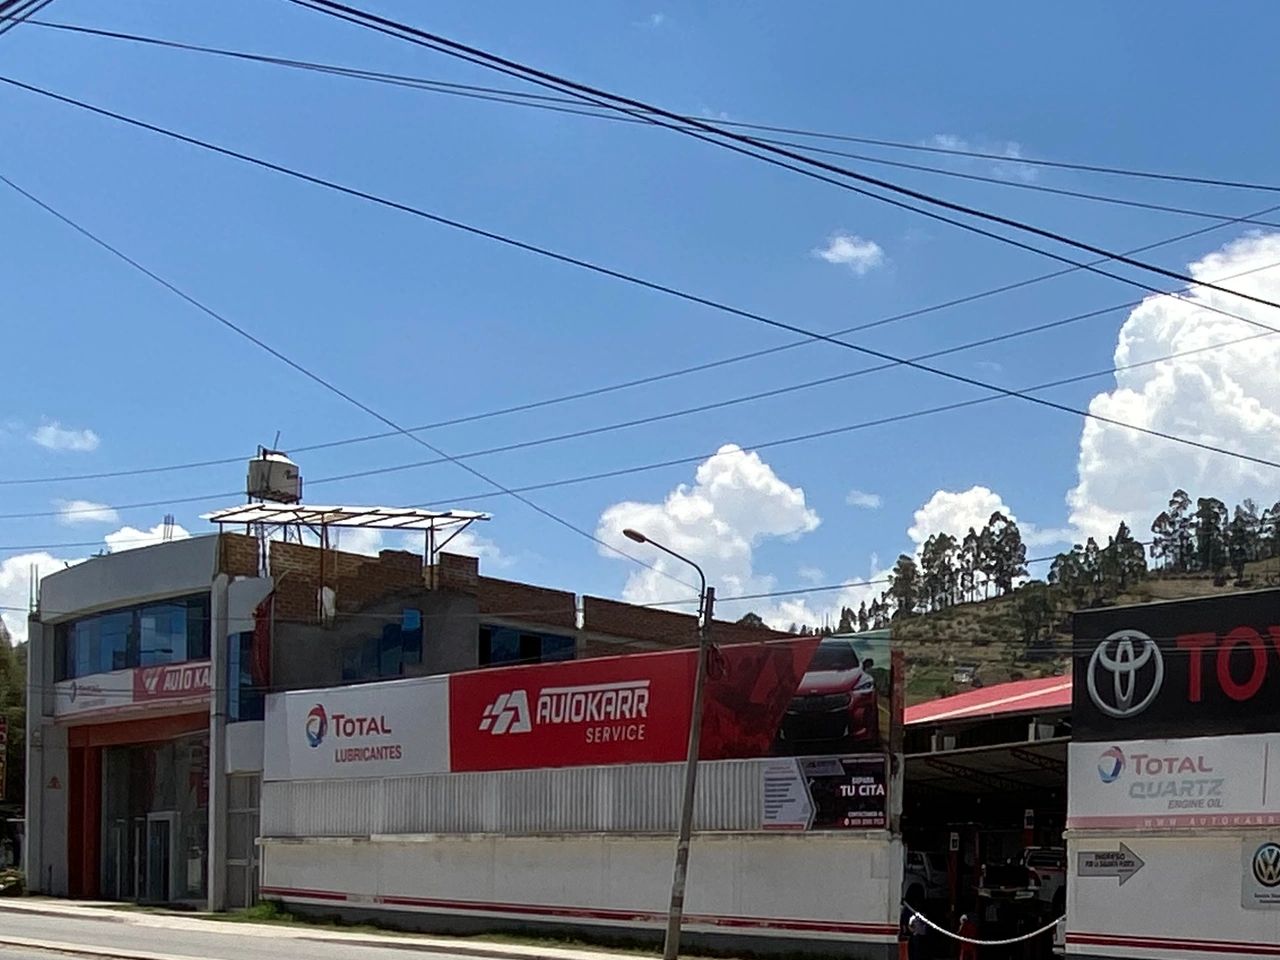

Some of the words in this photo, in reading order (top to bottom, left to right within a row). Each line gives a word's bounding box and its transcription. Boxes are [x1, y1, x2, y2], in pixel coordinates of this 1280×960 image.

[163, 667, 192, 691] AUTO
[536, 680, 650, 724] AUTOKARR
[332, 714, 392, 737] TOTAL
[586, 724, 645, 743] SERVICE
[335, 745, 402, 763] LUBRICANTES
[1130, 754, 1213, 775] TOTAL
[840, 785, 856, 797] TU
[858, 784, 885, 796] CITA
[1128, 778, 1225, 799] QUARTZ
[1168, 799, 1204, 809] ENGINE
[1207, 798, 1223, 808] OIL
